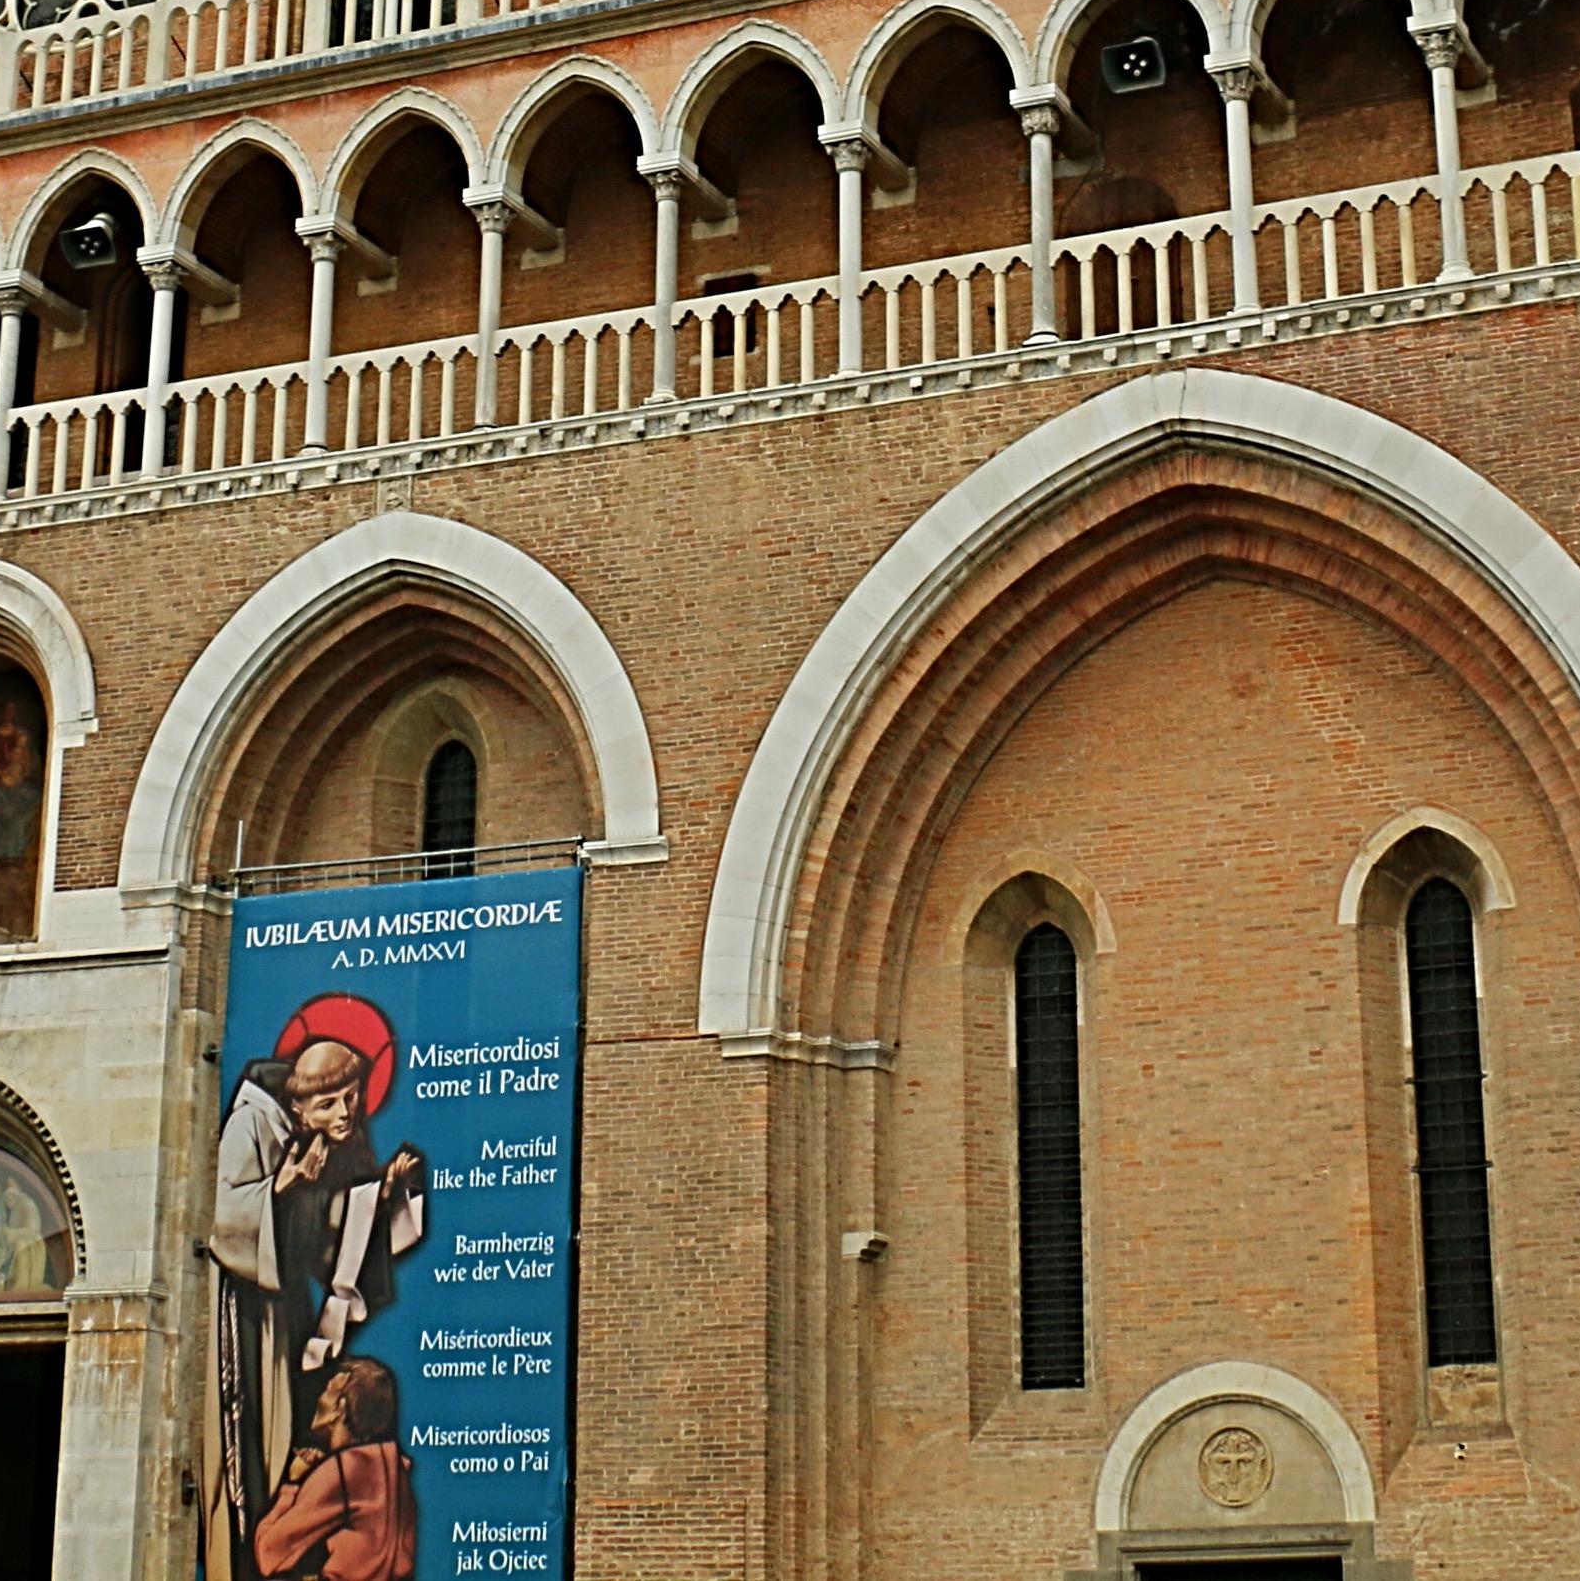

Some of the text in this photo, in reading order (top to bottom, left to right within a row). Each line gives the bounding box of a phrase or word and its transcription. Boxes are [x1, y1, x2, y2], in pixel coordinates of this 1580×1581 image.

[246, 899, 563, 948] IUBILÆUM MISERICORDIÆ
[331, 940, 466, 970] A. D. MMXVI
[409, 1036, 560, 1068] Misericordiosi
[416, 1066, 560, 1099] come il Padre
[481, 1135, 557, 1161] Merciful
[433, 1163, 557, 1190] like the Father
[455, 1232, 555, 1256] Barmherzig
[434, 1258, 555, 1283] wie der Vater
[420, 1326, 553, 1351] Miséricordieux
[422, 1353, 552, 1378] comme le Père
[410, 1422, 551, 1447] Misericordiosos
[450, 1449, 549, 1473] como o Pai
[452, 1521, 548, 1543] Miłosierni
[456, 1548, 547, 1576] jak Ojciec
